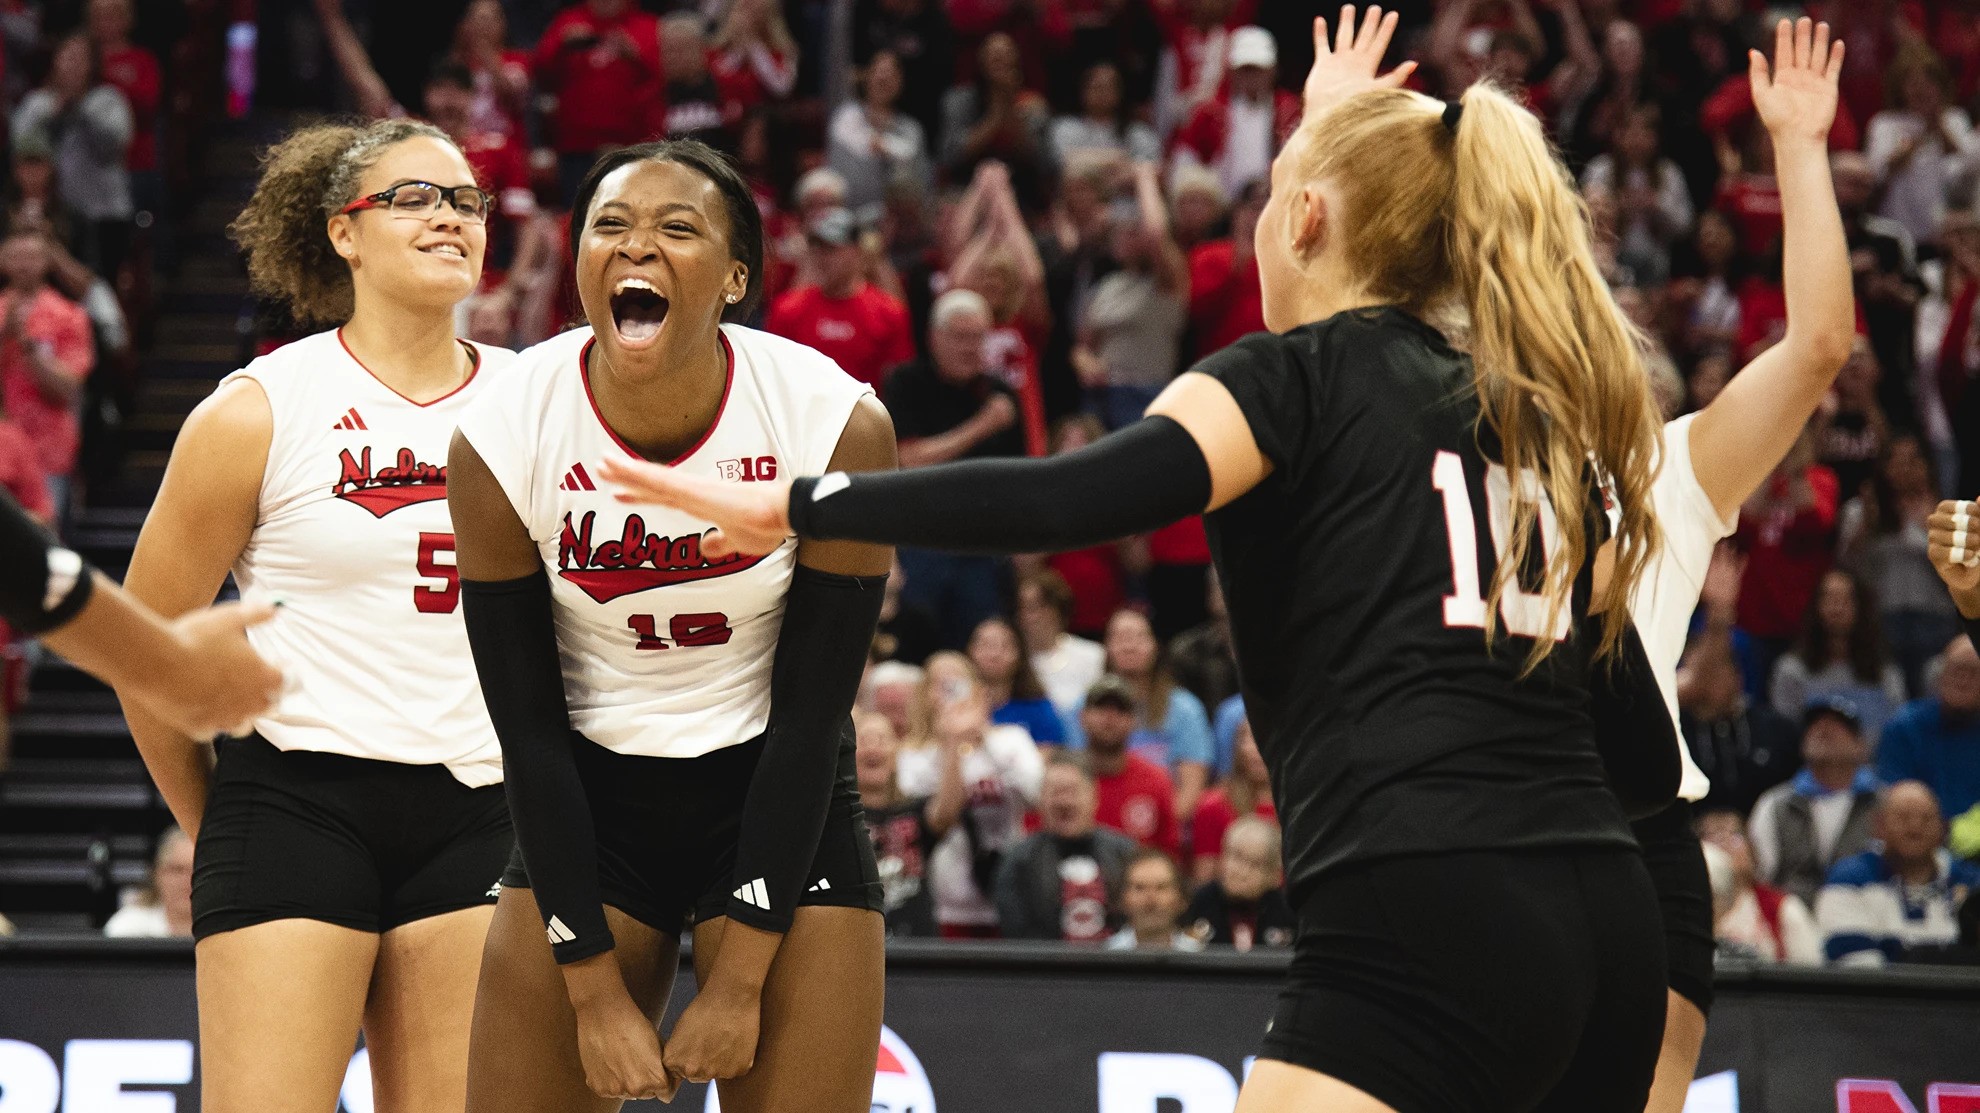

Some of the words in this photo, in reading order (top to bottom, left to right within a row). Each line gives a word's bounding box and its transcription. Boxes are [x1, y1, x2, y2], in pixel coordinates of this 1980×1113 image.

[332, 446, 449, 494] Nebr
[414, 532, 461, 613] 5
[558, 511, 742, 570] Nebra
[1432, 449, 1574, 643] 10
